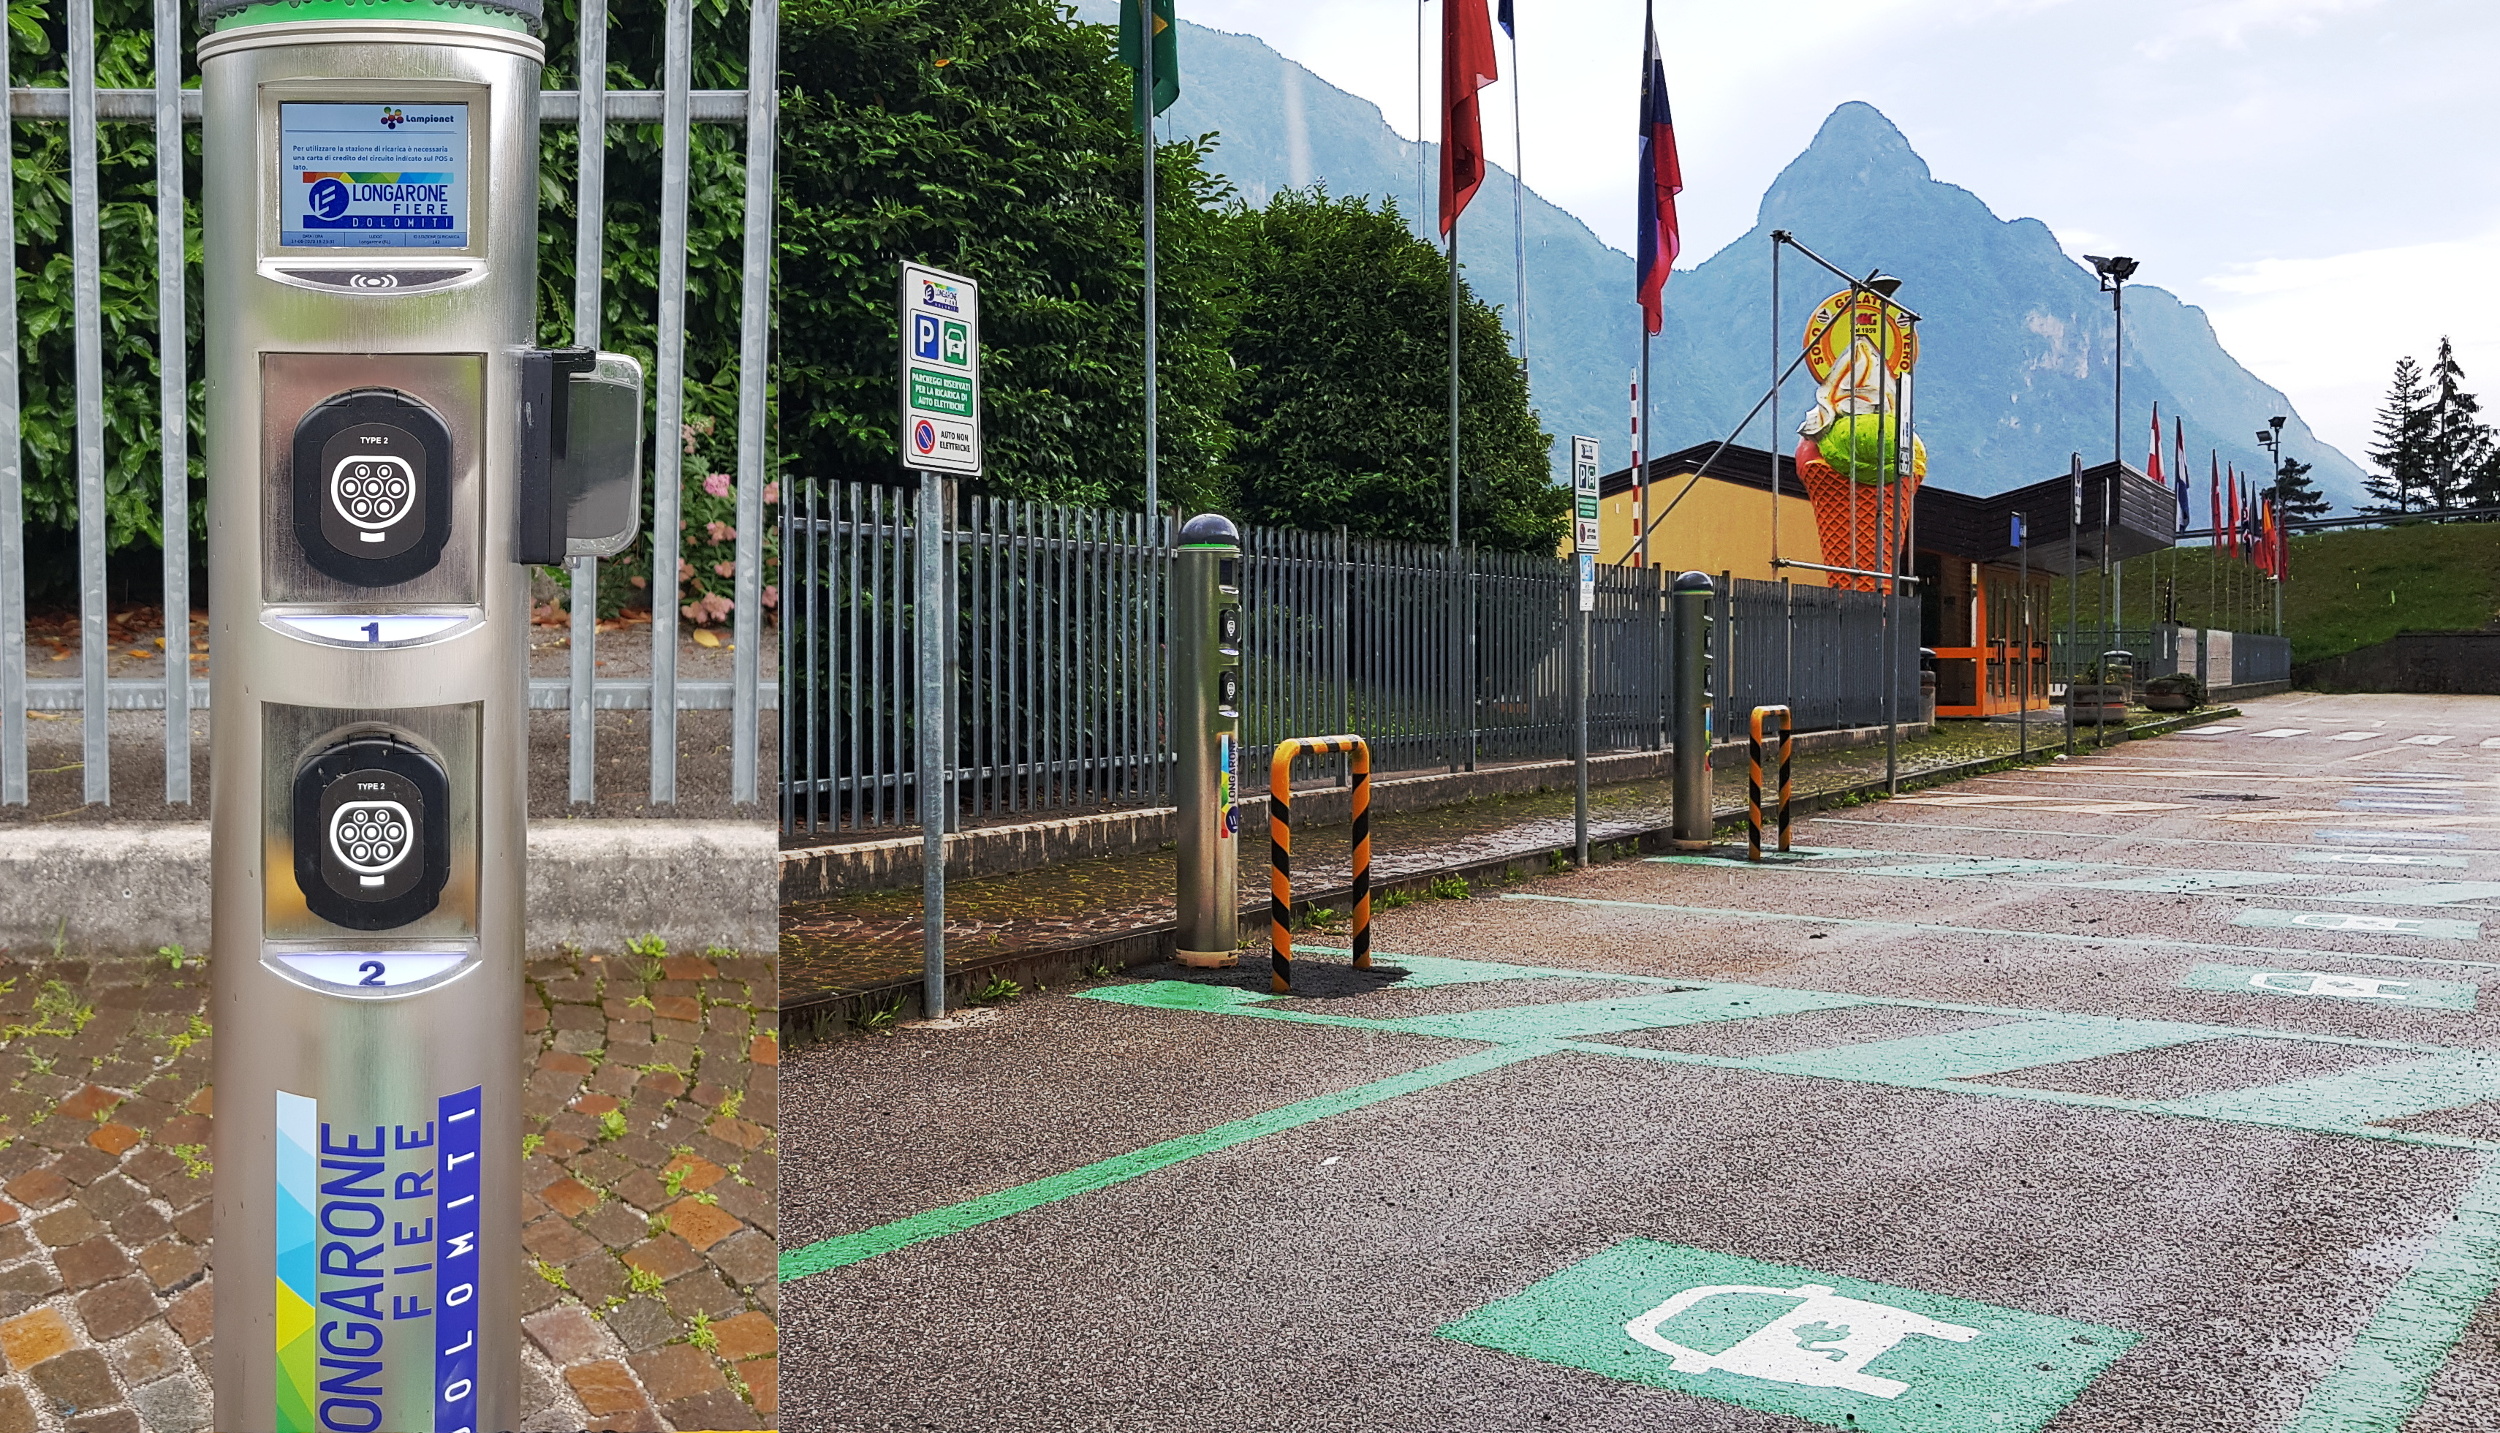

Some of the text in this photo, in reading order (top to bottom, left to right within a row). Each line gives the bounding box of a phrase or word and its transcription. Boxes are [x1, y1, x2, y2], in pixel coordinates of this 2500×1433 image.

[407, 114, 454, 124] Lampionet
[353, 184, 448, 202] LONGARONE
[394, 203, 448, 214] FIERE
[353, 217, 448, 227] DOLOMITI
[1835, 295, 1889, 309] GLAT
[920, 318, 935, 353] P
[1811, 327, 1824, 365] SOO
[1900, 333, 1911, 371] VERO
[913, 372, 942, 386] PARCHEGGI
[916, 384, 926, 394] PER
[927, 387, 934, 395] LA
[961, 393, 968, 401] DI
[919, 396, 933, 406] AUTO
[942, 430, 969, 442] AUTO NON
[941, 440, 971, 452] ELETTRICHE
[361, 622, 379, 642] 1
[358, 960, 386, 986] 2
[393, 1120, 435, 1321] FIERE
[444, 1108, 476, 1433] OLOMITI
